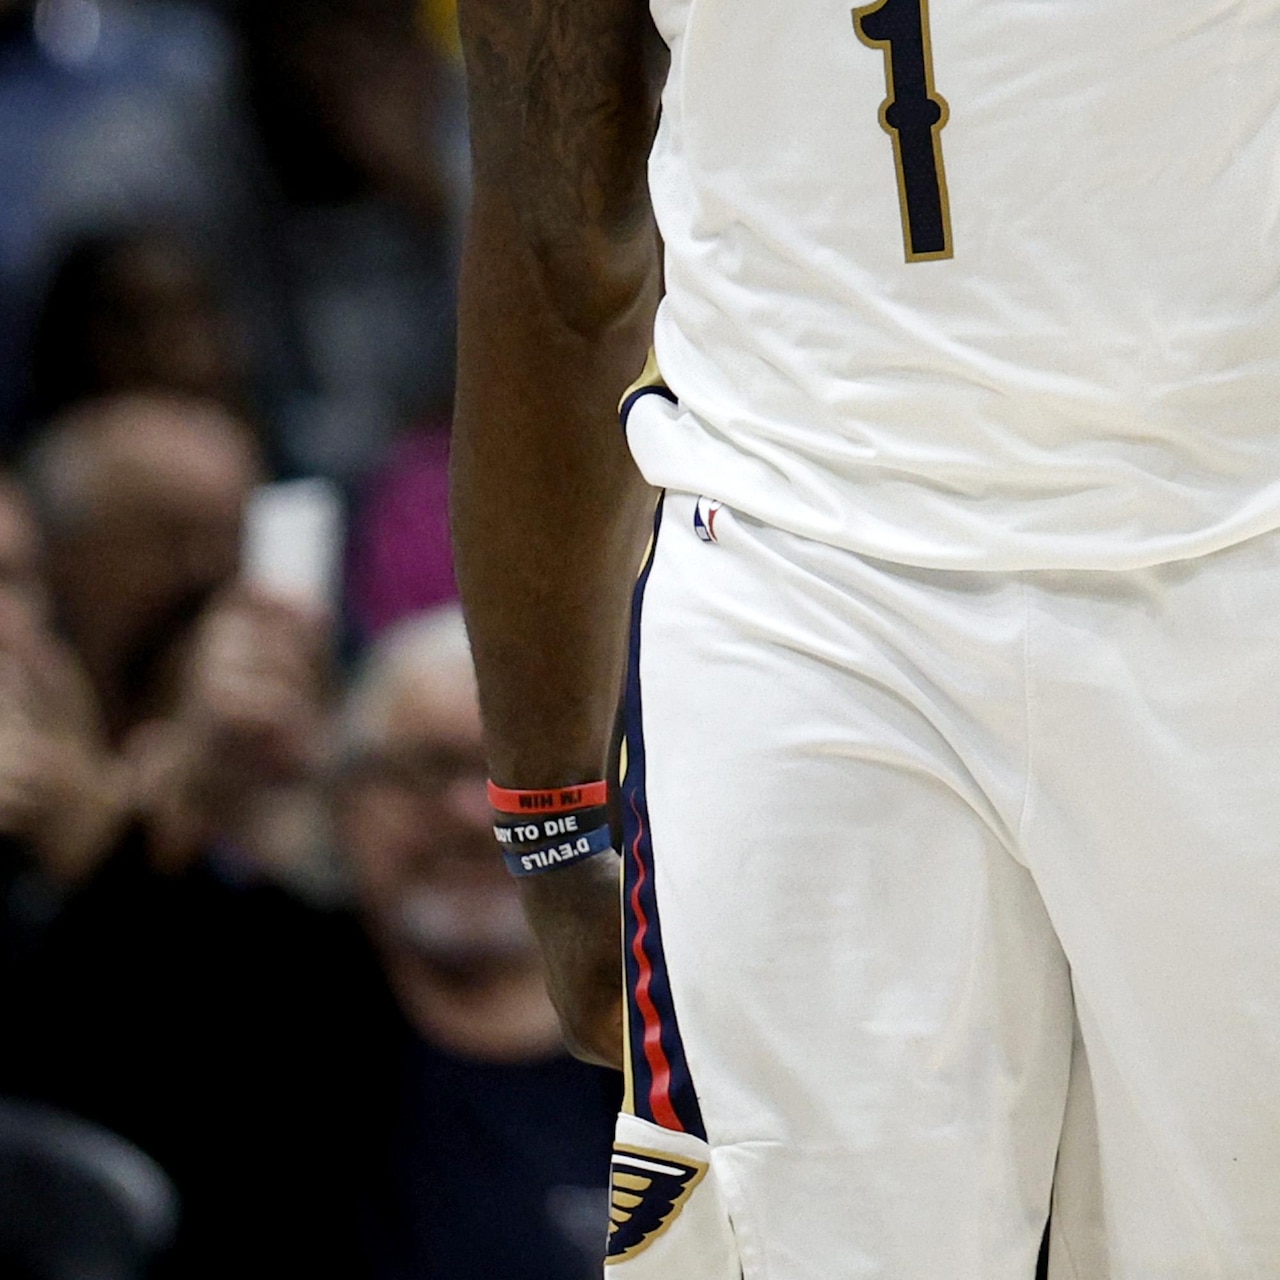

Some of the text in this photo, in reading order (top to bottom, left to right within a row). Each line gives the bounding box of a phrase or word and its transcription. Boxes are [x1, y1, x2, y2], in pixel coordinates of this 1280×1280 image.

[514, 825, 539, 842] TO
[544, 816, 578, 837] DIE
[521, 837, 590, 870] D'EVILS
